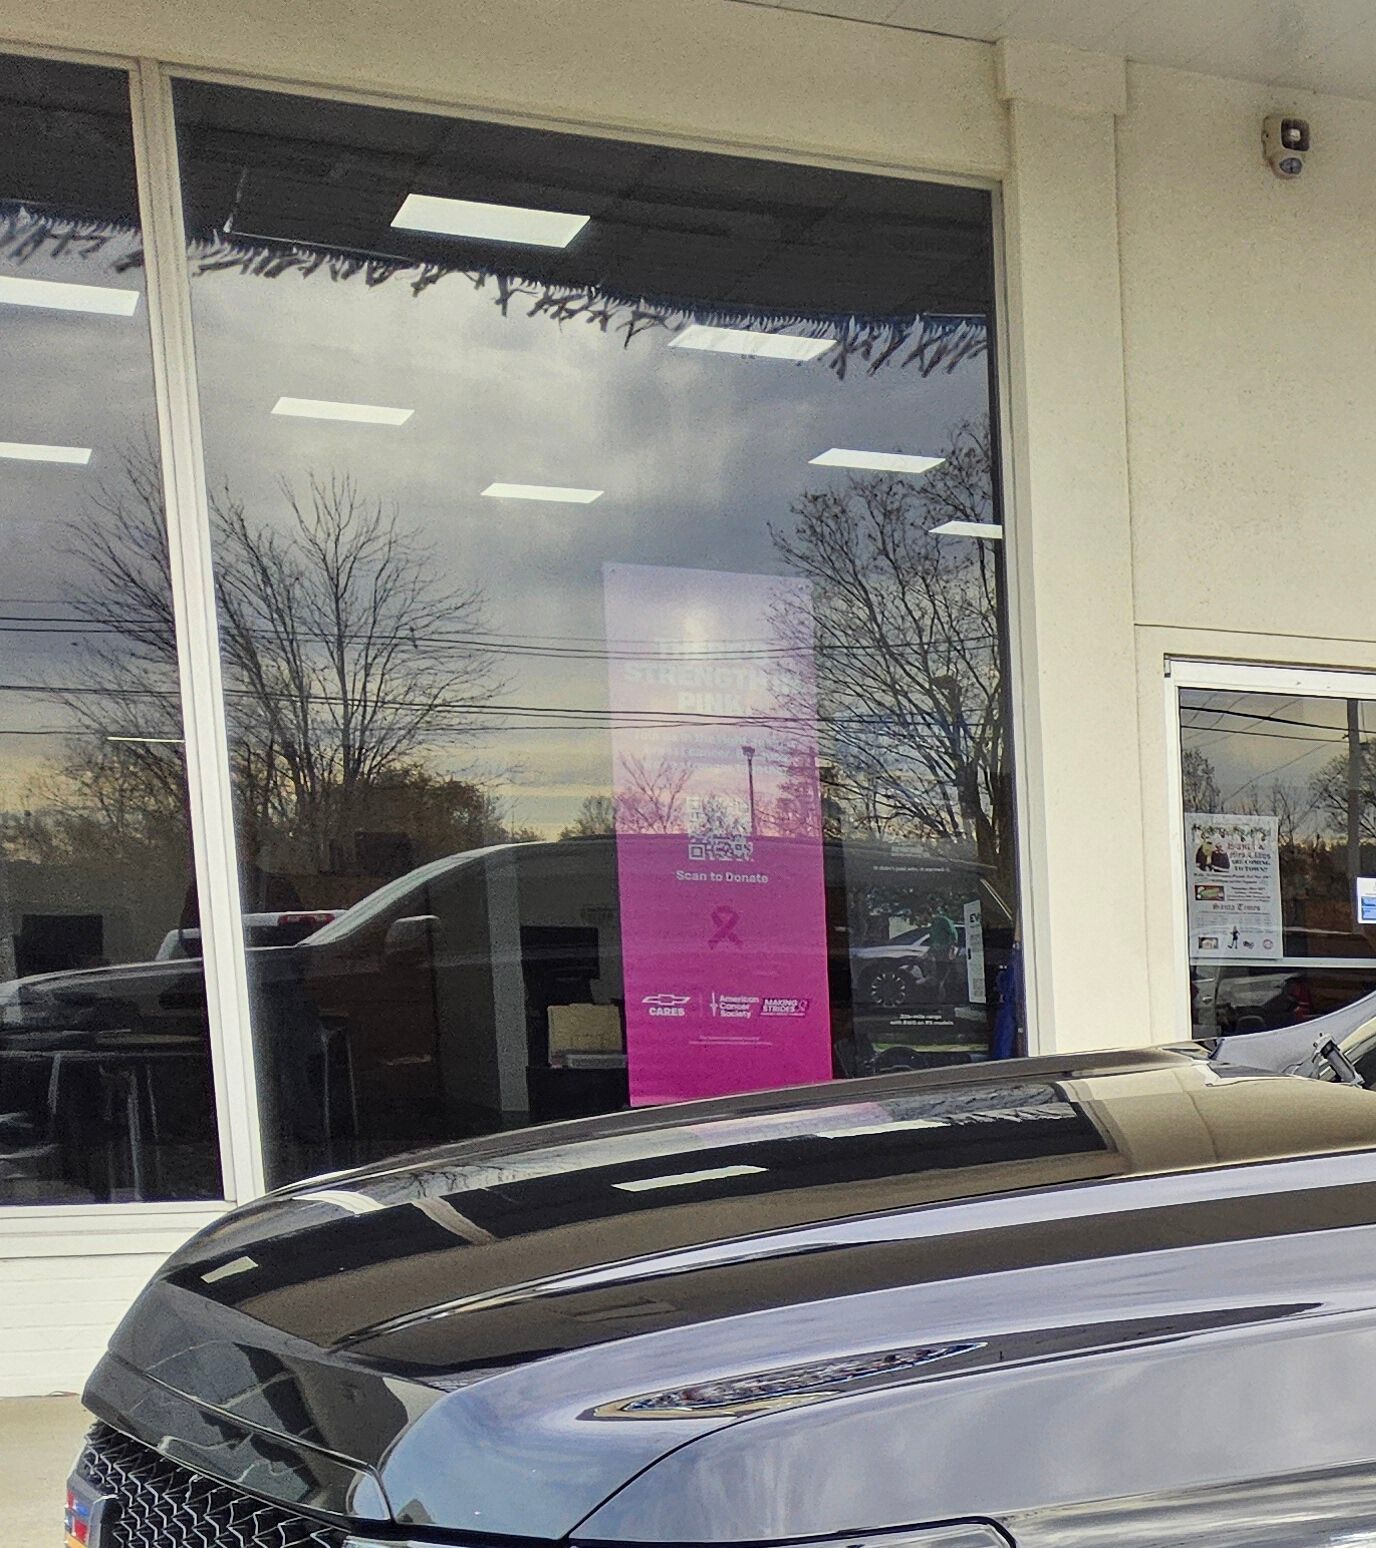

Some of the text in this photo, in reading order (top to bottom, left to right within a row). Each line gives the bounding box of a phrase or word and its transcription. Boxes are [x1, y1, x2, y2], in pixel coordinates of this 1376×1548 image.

[676, 870, 769, 883] Scan to Donate
[719, 995, 760, 1004] American
[649, 1007, 686, 1017] CARES
[762, 1005, 796, 1013] STRIDES
[720, 1010, 752, 1019] Society
